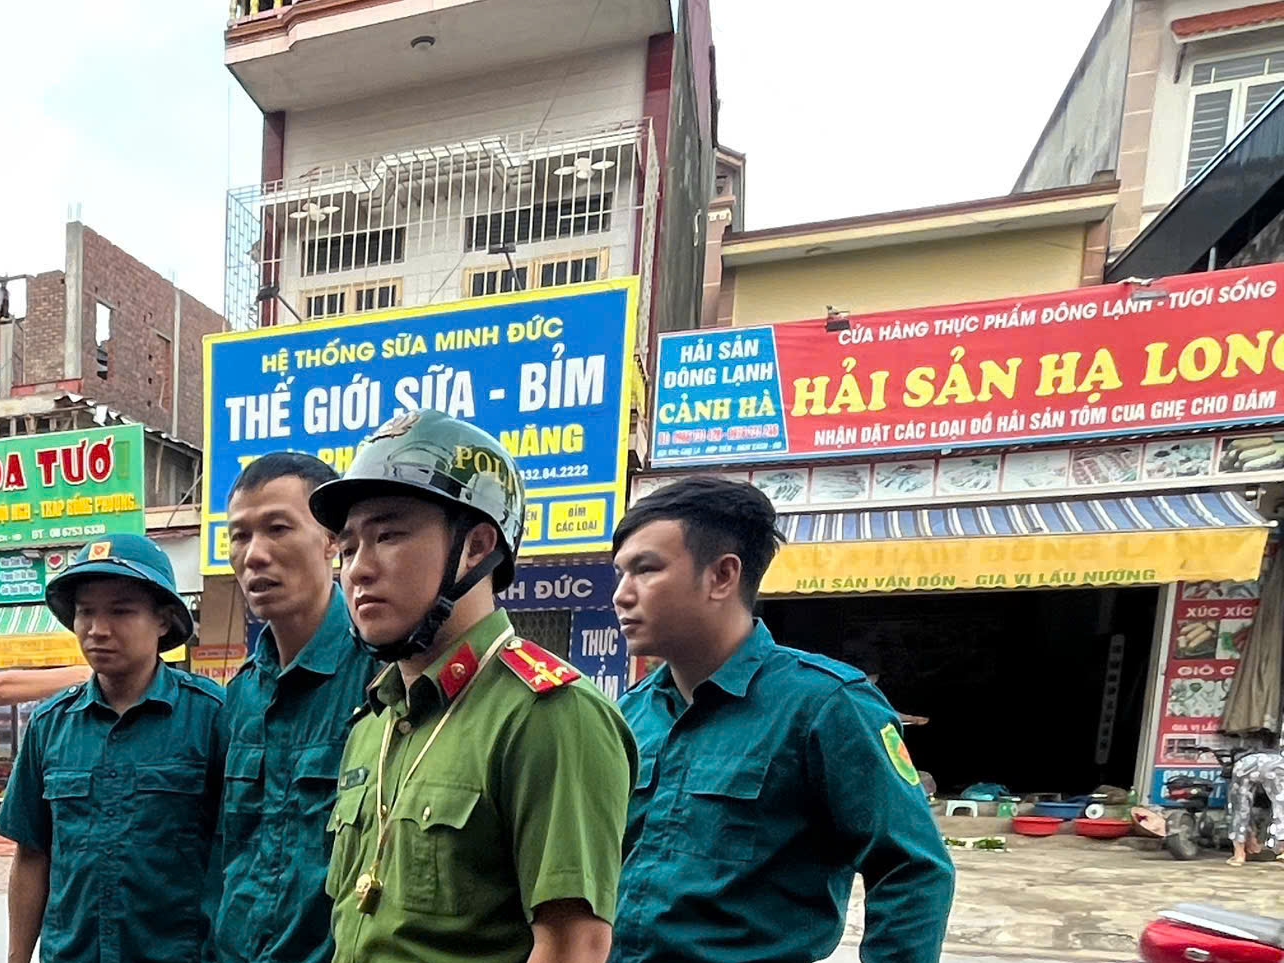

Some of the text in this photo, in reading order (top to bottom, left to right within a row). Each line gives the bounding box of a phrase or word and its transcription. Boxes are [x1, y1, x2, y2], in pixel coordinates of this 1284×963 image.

[838, 323, 873, 345] CỬA
[879, 319, 929, 342] HÀNG
[934, 313, 980, 338] THỰC
[983, 303, 1037, 331] PHẨM
[1041, 301, 1098, 324] ĐÔNG
[1169, 287, 1214, 310] TƯƠI
[1218, 276, 1277, 304] SỐNG
[262, 314, 564, 376] HỆ THỐNG SỮA MINH ĐỨC
[680, 334, 759, 363] HẢI SẢN
[225, 376, 295, 443] THẾ
[304, 373, 381, 435] GIỚI
[394, 364, 476, 419] SỮA
[519, 342, 606, 413] BỈM
[663, 362, 774, 389] ĐÔNG LẠNH
[790, 356, 890, 418] HẢI
[903, 345, 1023, 408] SẢN
[1034, 348, 1124, 404] HẠ
[658, 392, 732, 424] CẢNH
[814, 426, 857, 448] NHẬN
[894, 419, 926, 441] CÁC
[930, 419, 966, 443] LOẠI
[996, 407, 1026, 432] HẢI
[1029, 404, 1065, 430] SẢN
[1070, 403, 1107, 427] TÔM
[1111, 403, 1145, 423] CUA
[1150, 399, 1187, 421] GHẸ
[1191, 396, 1223, 416] CHO
[499, 423, 584, 458] NĂNG
[534, 575, 593, 599] ĐỨC
[975, 574, 1007, 586] GIA
[581, 626, 619, 662] THỰC
